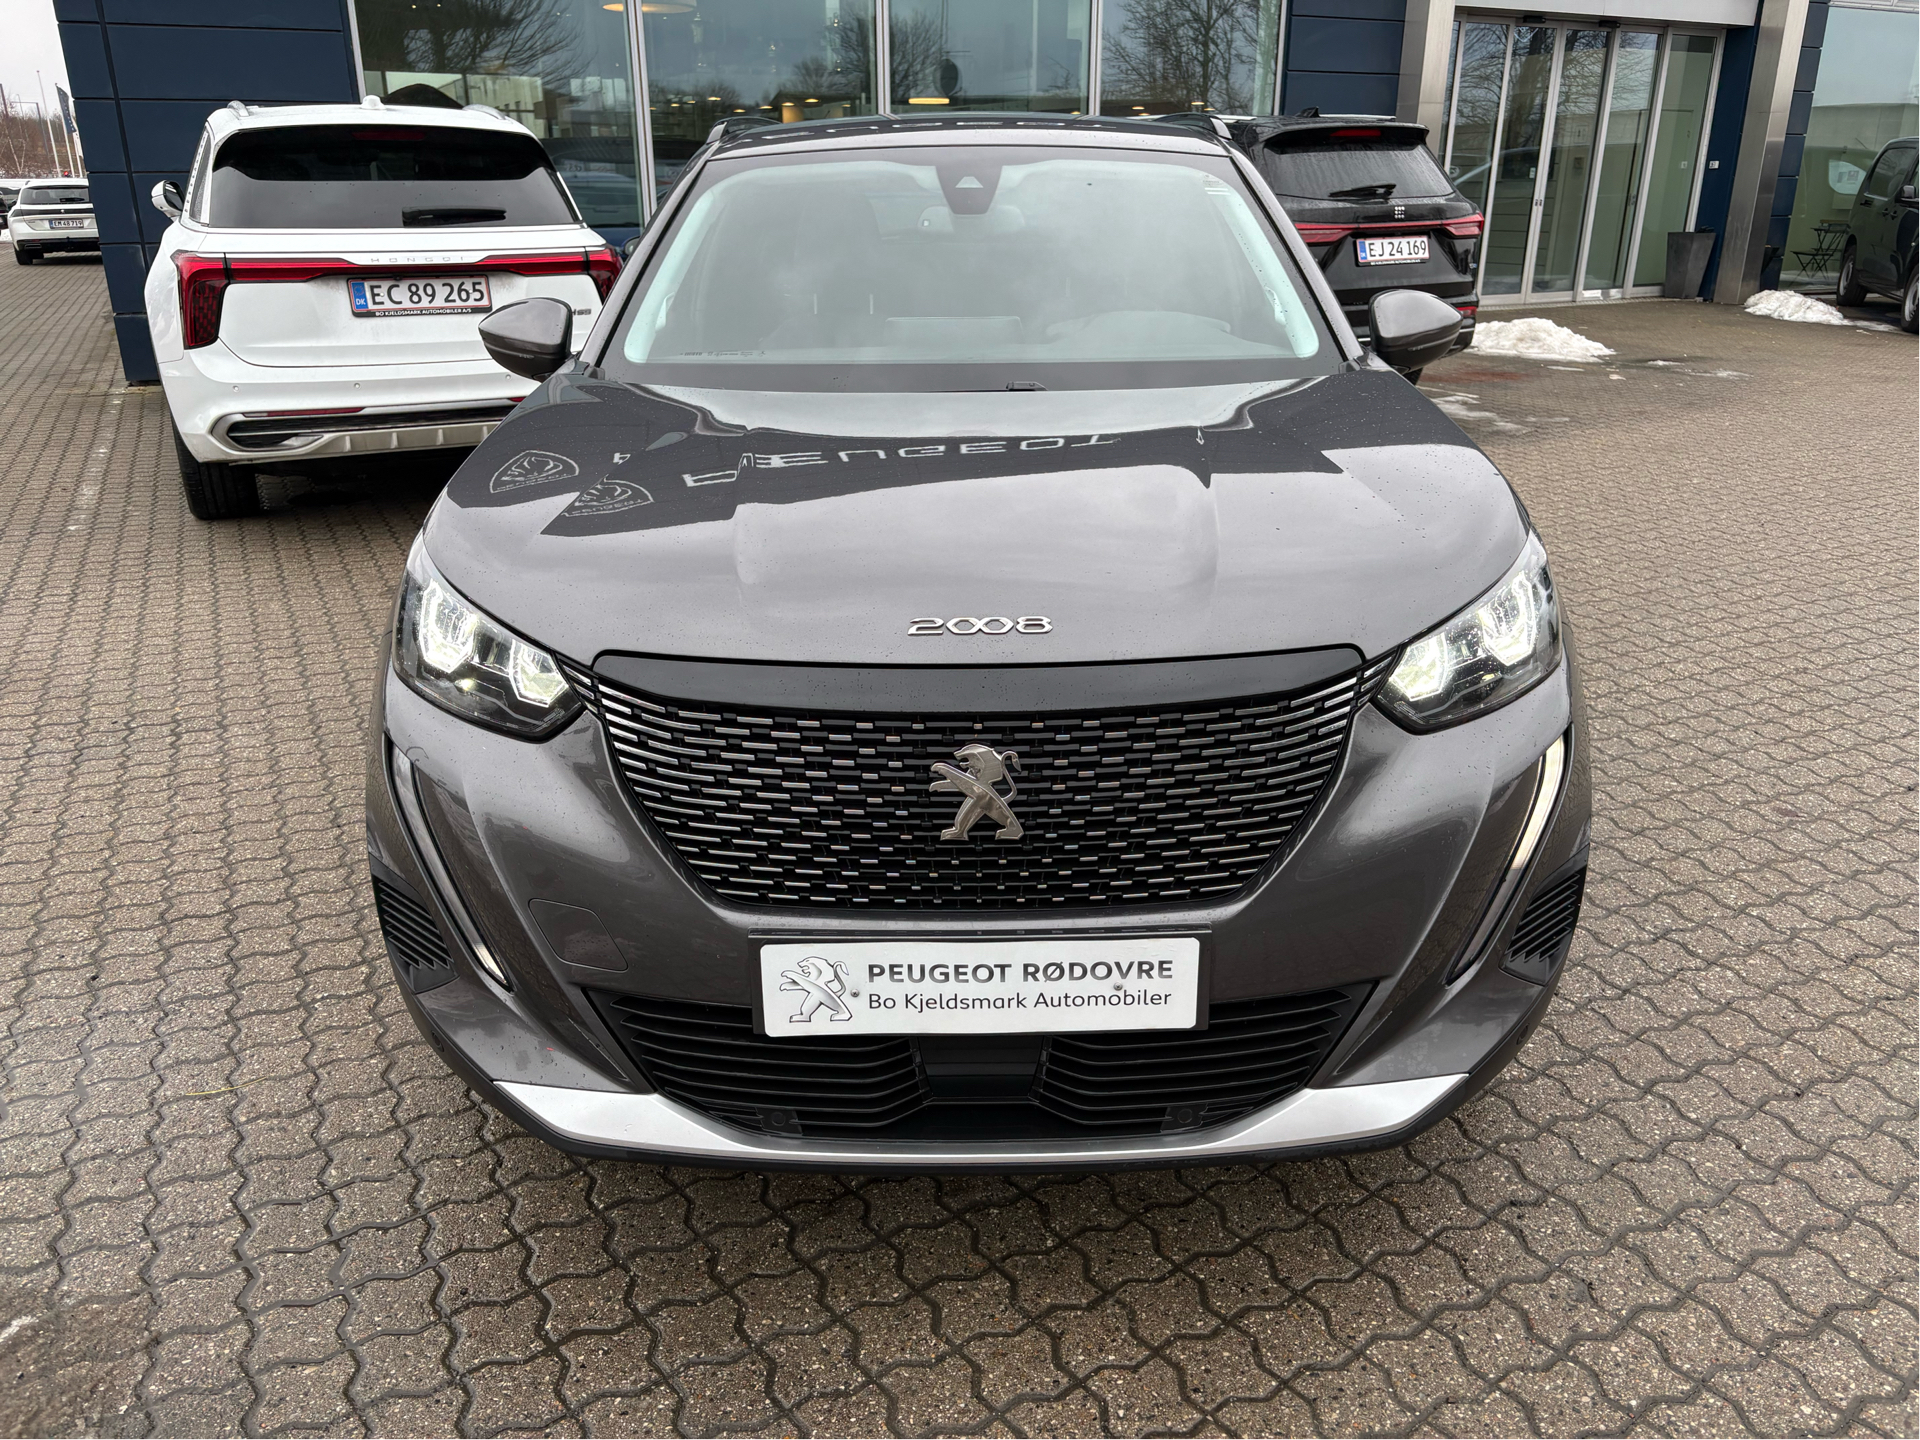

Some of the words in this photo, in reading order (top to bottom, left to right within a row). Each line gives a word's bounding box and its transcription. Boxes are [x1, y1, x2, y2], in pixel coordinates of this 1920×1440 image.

[1368, 242, 1385, 257] EJ
[1388, 241, 1403, 256] 24
[1407, 240, 1427, 255] 169
[370, 284, 403, 306] EC
[407, 283, 437, 304] 89
[441, 281, 485, 303] 265
[907, 616, 1053, 636] 2008
[868, 963, 1012, 983] PEUGEOT
[1022, 960, 1174, 983] RØDOVRE
[868, 994, 897, 1010] Bo
[905, 992, 1028, 1013] Kjeldsmark
[1034, 991, 1172, 1009] Automobiler
